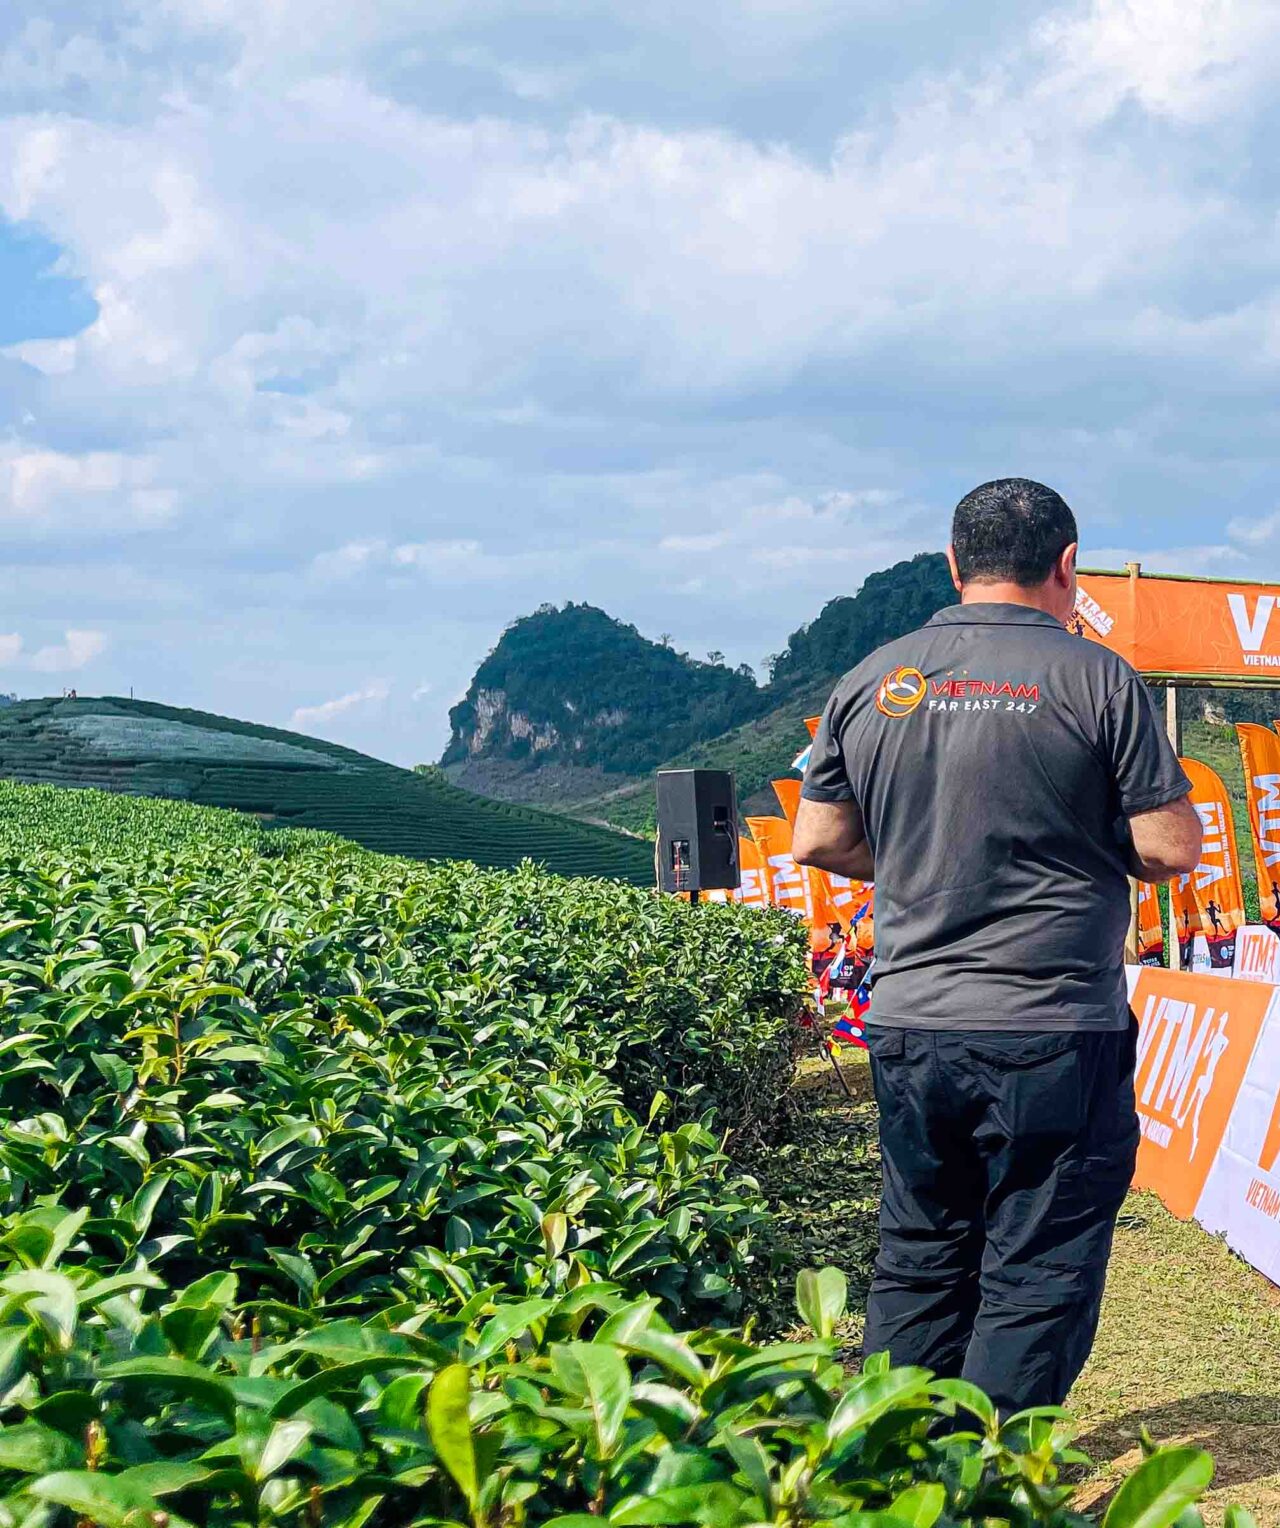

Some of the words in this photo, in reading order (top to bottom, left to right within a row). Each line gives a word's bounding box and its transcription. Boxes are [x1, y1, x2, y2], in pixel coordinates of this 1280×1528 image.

[931, 680, 1040, 702] VIETNAM
[928, 700, 958, 712] FAR
[964, 700, 1000, 712] EAST
[1005, 701, 1037, 714] 247
[1241, 934, 1271, 972] VTM
[1133, 993, 1215, 1120] VTM
